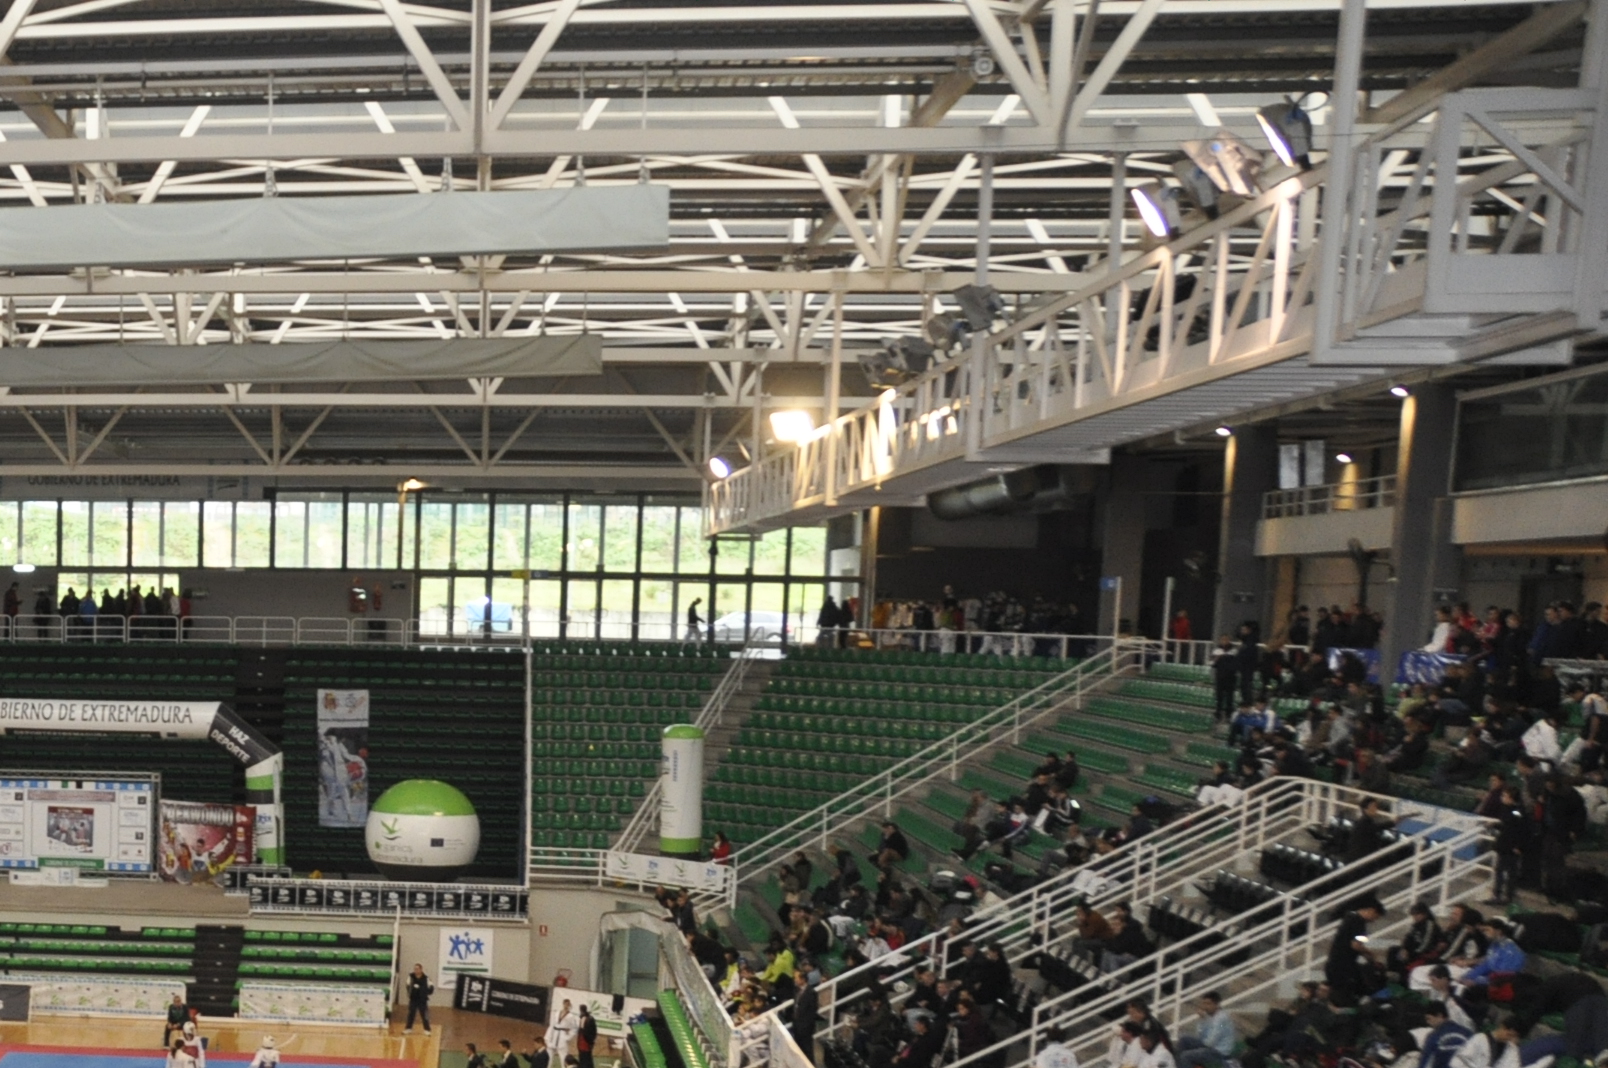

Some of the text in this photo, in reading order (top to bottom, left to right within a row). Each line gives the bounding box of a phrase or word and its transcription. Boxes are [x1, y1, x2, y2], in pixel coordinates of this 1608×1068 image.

[85, 474, 100, 486] DE
[58, 703, 77, 722] DE
[81, 704, 192, 724] EXTREMADURA
[210, 729, 251, 763] DEPORTE
[228, 725, 250, 746] HAZ
